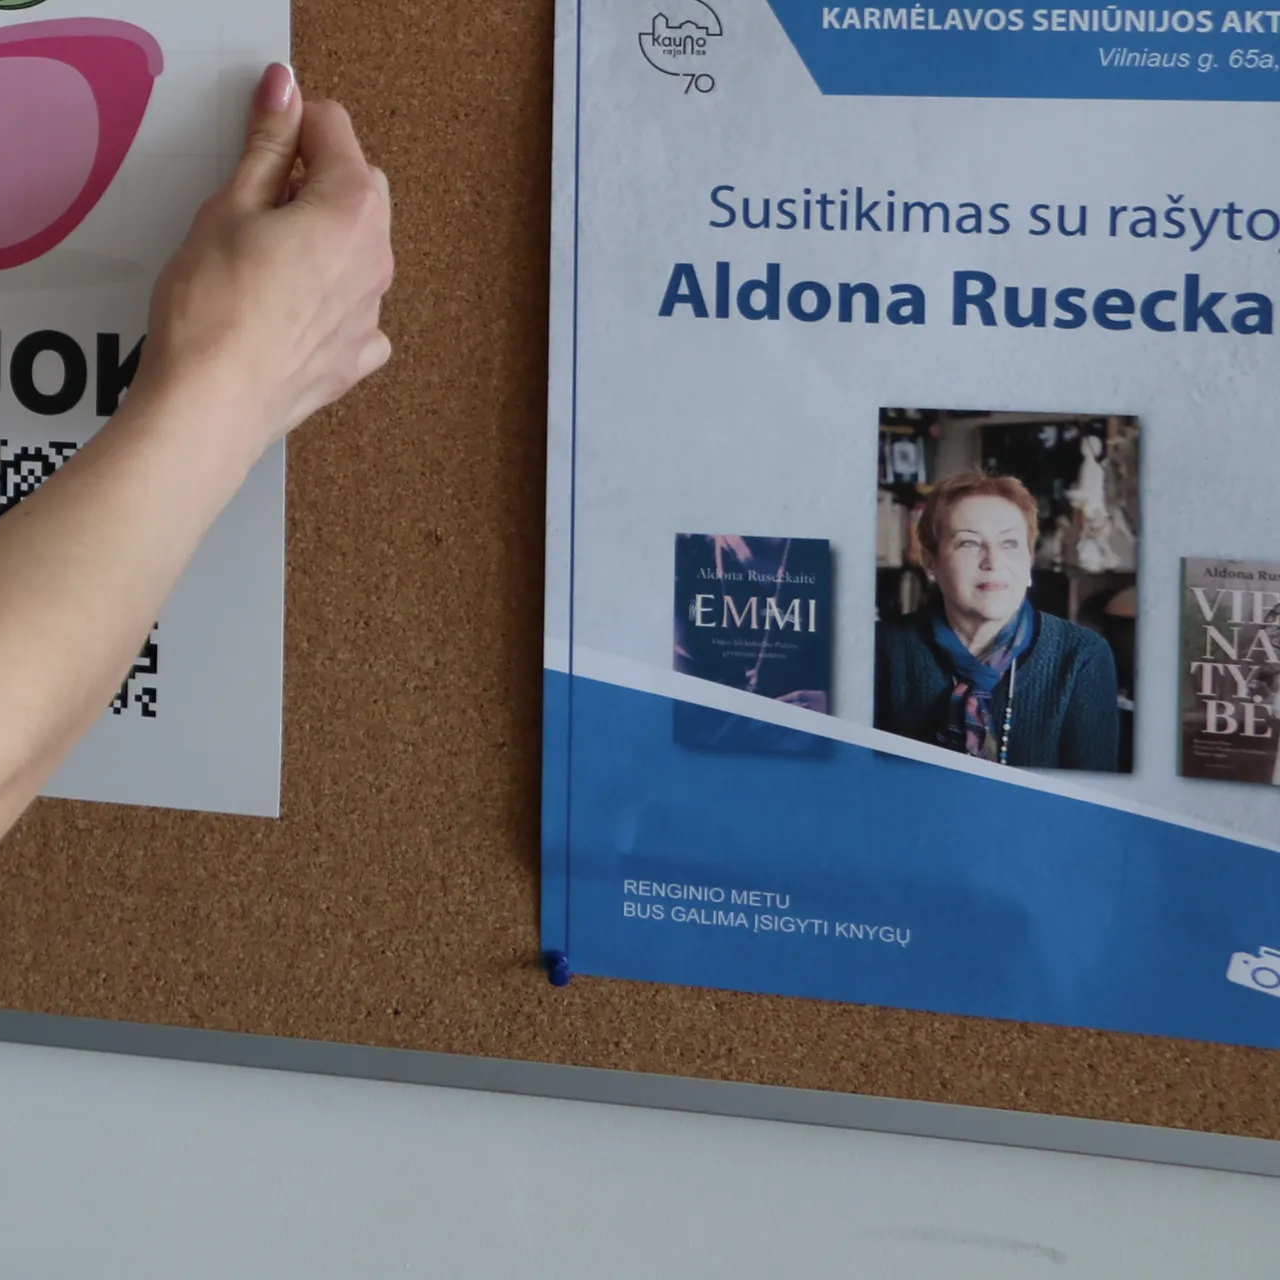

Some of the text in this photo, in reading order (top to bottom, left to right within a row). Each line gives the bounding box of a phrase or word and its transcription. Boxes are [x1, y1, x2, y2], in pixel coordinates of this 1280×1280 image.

[822, 3, 1213, 33] KARMĖLAVOS SENIŪNIJOS
[1099, 48, 1218, 73] Vilniaus g.
[682, 73, 715, 94] 70
[709, 185, 1087, 236] Susitikimas su
[658, 261, 1273, 335] Aldona Rusecka
[700, 568, 742, 580] Aldona
[1205, 567, 1254, 580] Aldona
[693, 593, 817, 633] EMMI
[624, 879, 789, 909] RENGINIO METU
[623, 901, 910, 948] BUS GALIMA ĮSIGYTI KNYGŲ
